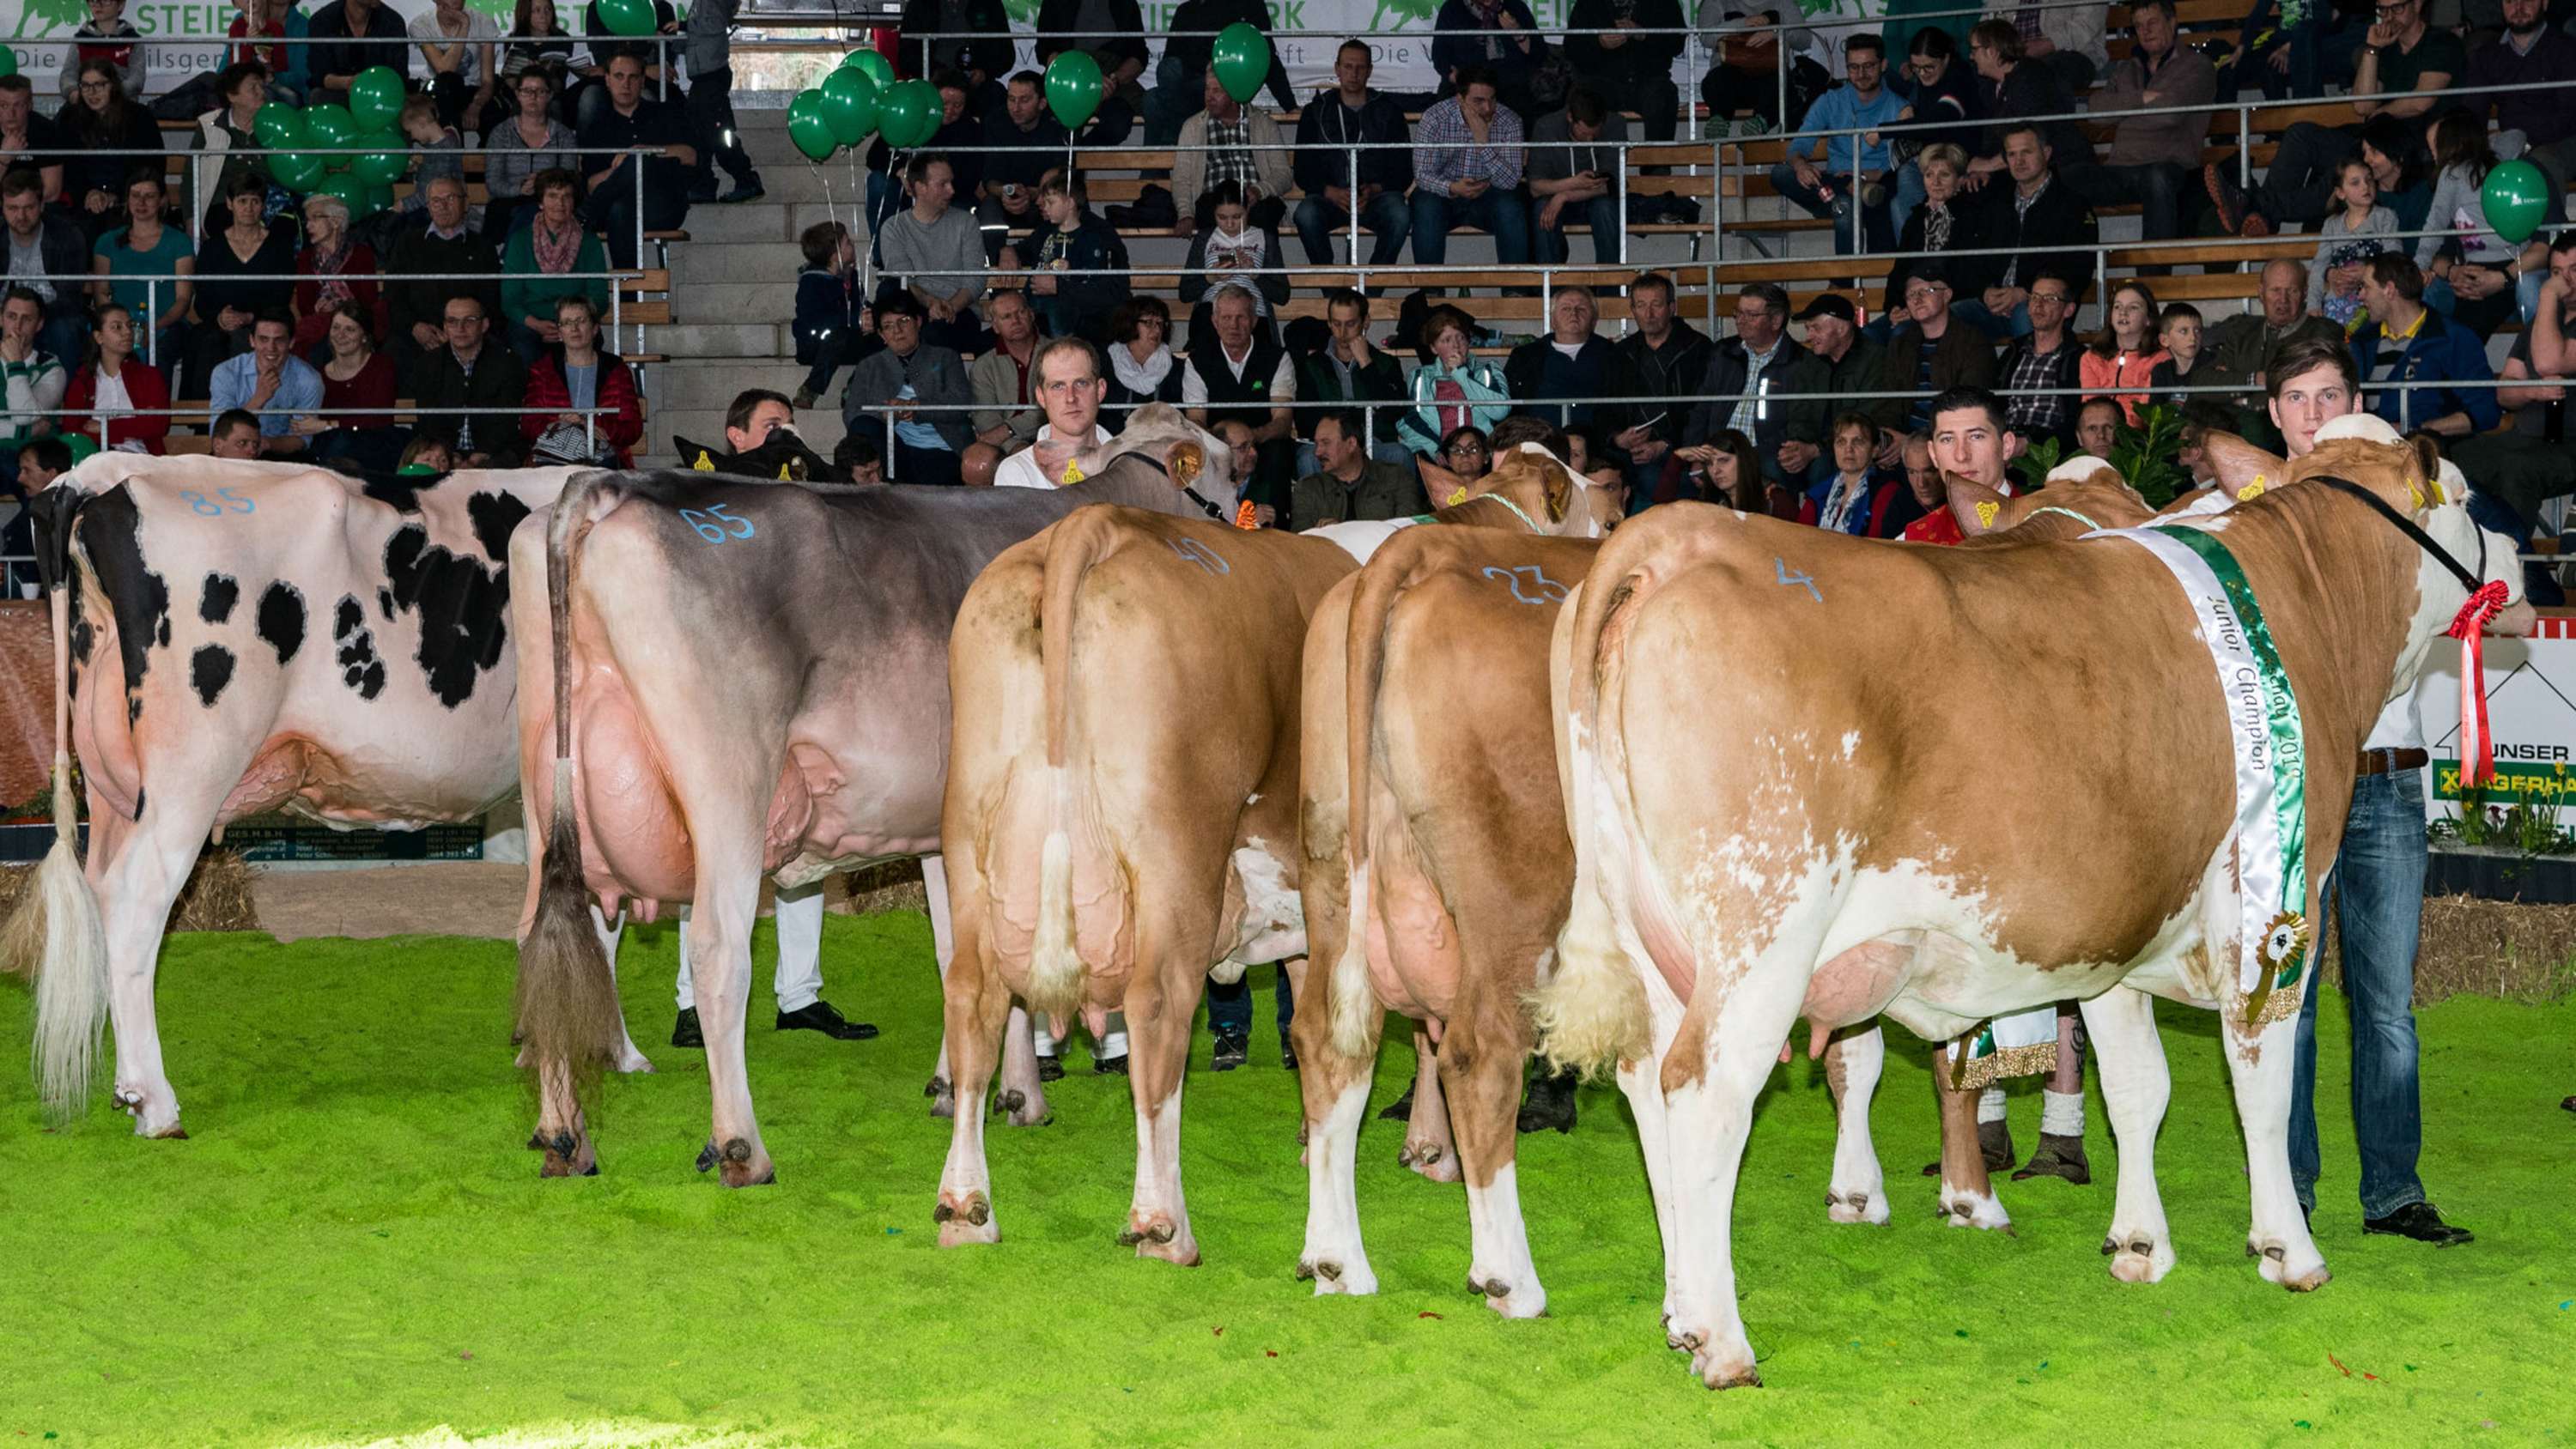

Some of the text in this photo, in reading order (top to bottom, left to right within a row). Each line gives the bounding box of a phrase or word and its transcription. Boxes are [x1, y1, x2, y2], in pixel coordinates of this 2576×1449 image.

[15, 48, 56, 68] Die
[1369, 43, 1409, 63] Die
[179, 487, 256, 517] 85
[679, 502, 755, 544] 65
[1482, 565, 1571, 604] 23
[1774, 556, 1823, 603] 4
[2207, 596, 2268, 771] Junior Champion
